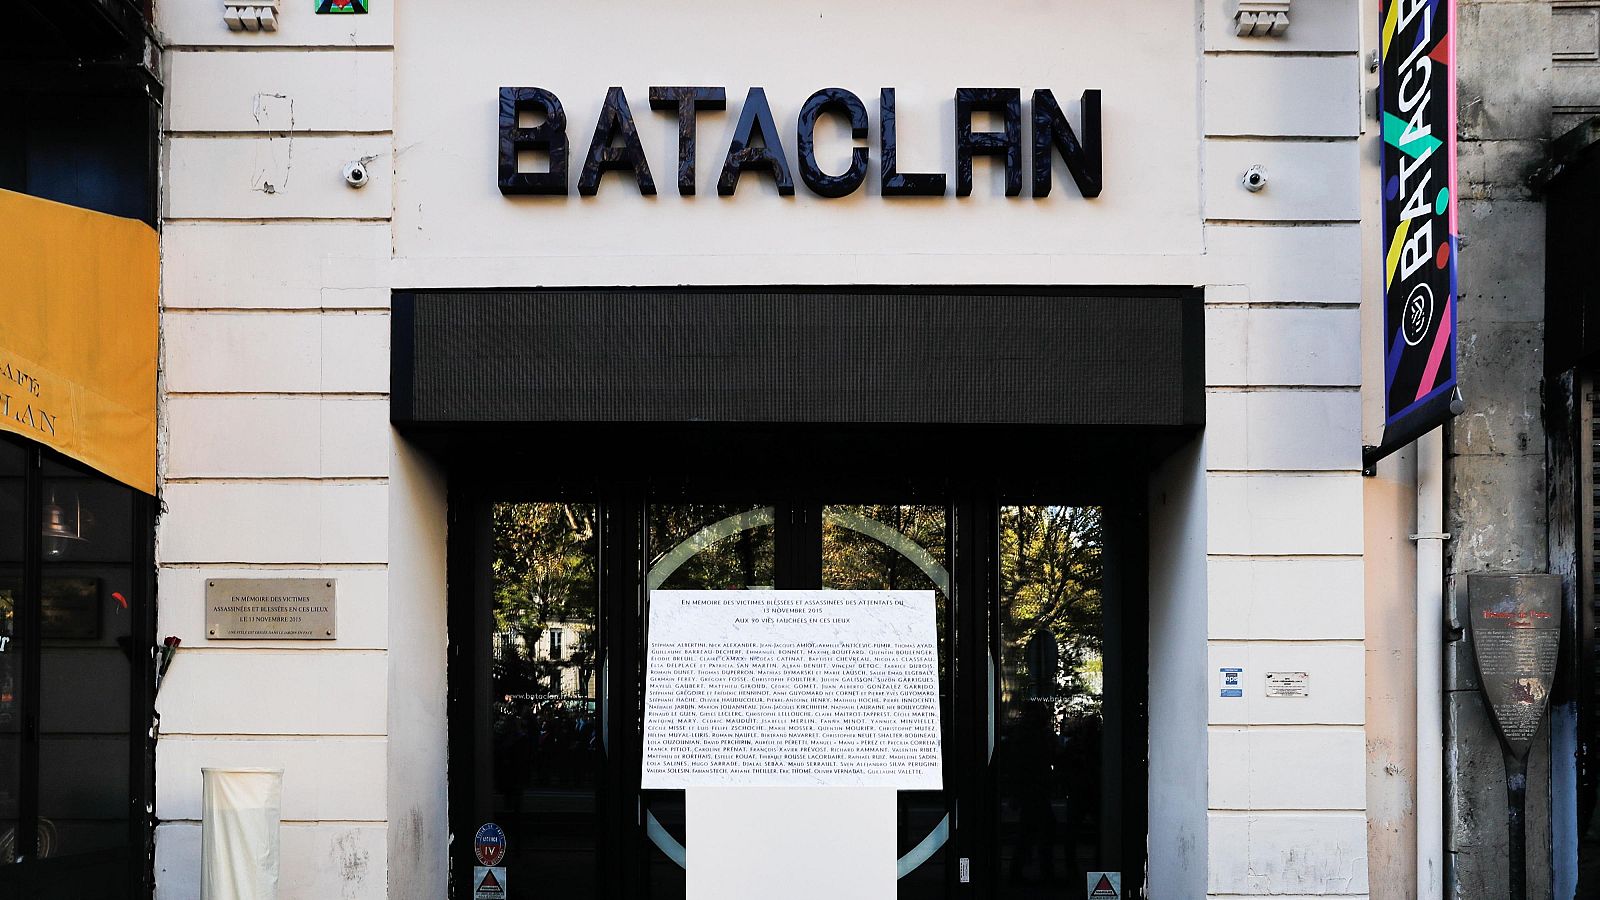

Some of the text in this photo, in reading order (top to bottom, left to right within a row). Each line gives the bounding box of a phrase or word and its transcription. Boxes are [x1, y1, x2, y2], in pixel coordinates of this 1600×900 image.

[498, 87, 1103, 199] BATACLAN
[0, 363, 40, 397] AFÉ
[0, 393, 57, 437] LAN
